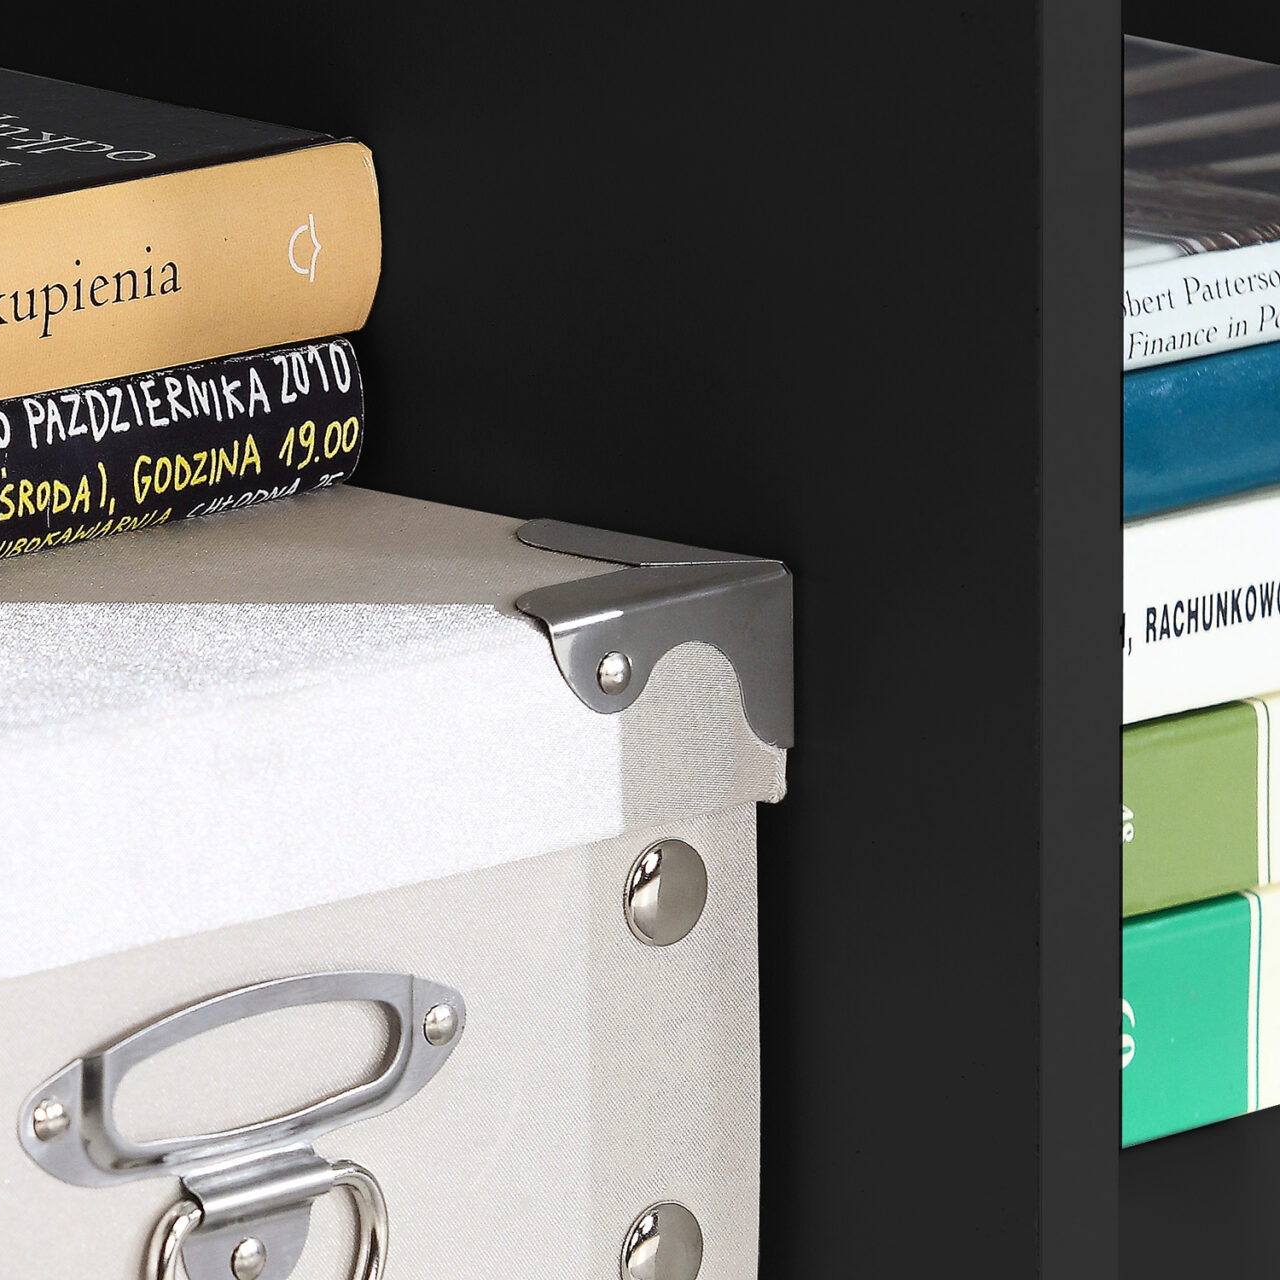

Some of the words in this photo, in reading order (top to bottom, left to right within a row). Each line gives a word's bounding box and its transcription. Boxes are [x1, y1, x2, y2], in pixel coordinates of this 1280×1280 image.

[1127, 326, 1218, 360] Finance
[1227, 317, 1248, 339] in
[273, 344, 351, 405] 2010
[133, 433, 262, 505] GODZINA
[278, 416, 360, 470] 19.00
[1145, 580, 1280, 644] RACHUNKOW
